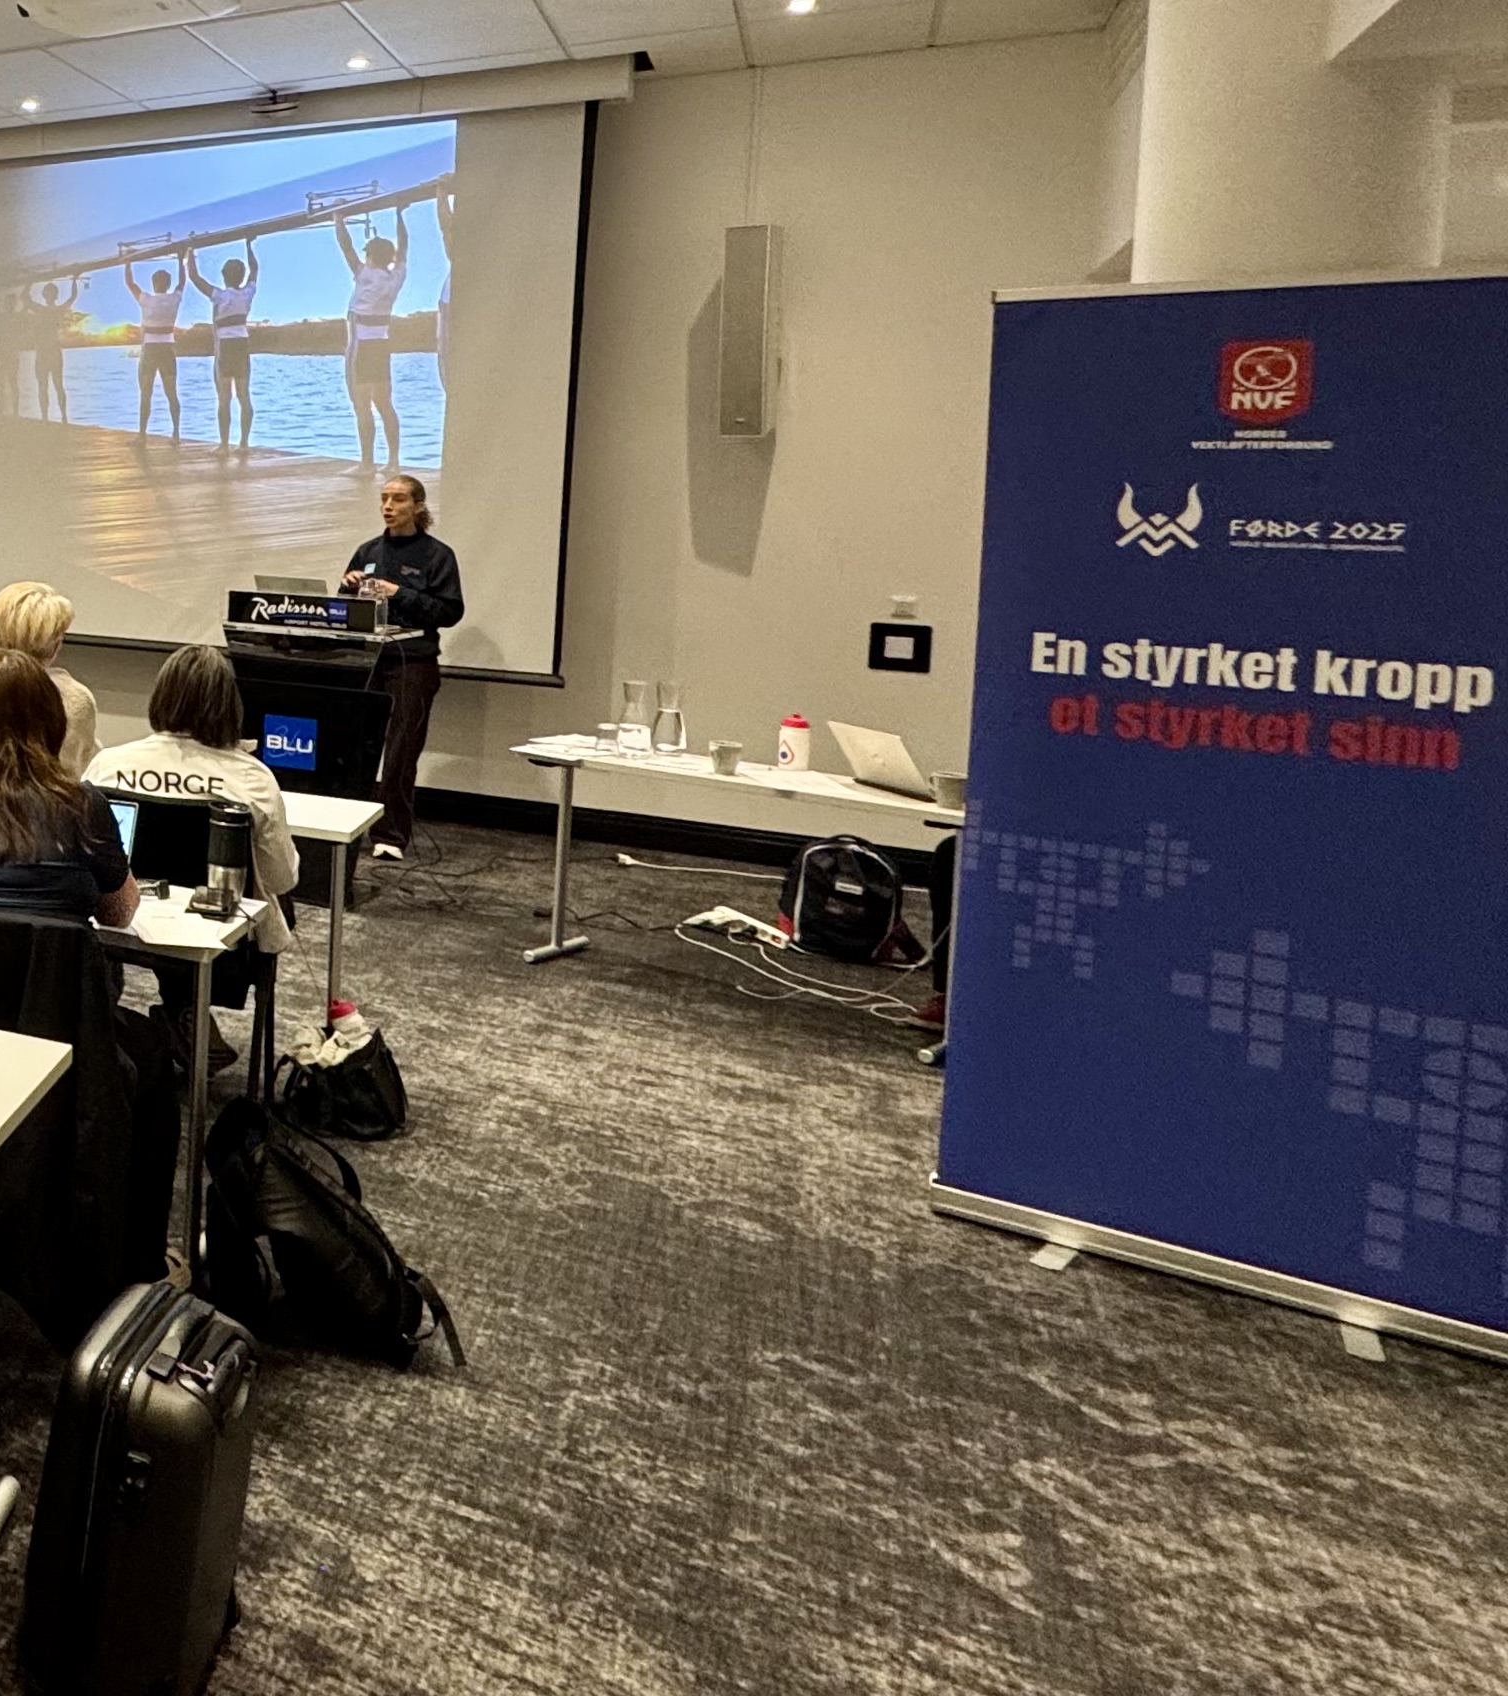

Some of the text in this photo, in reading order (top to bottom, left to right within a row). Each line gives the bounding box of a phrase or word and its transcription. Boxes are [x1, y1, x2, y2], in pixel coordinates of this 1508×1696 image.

[1230, 391, 1296, 410] NVF
[1329, 521, 1407, 540] 2025
[251, 595, 328, 621] Radisson
[1031, 632, 1494, 713] En styrket kropp
[266, 734, 314, 754] BLU
[116, 769, 225, 795] NORGE
